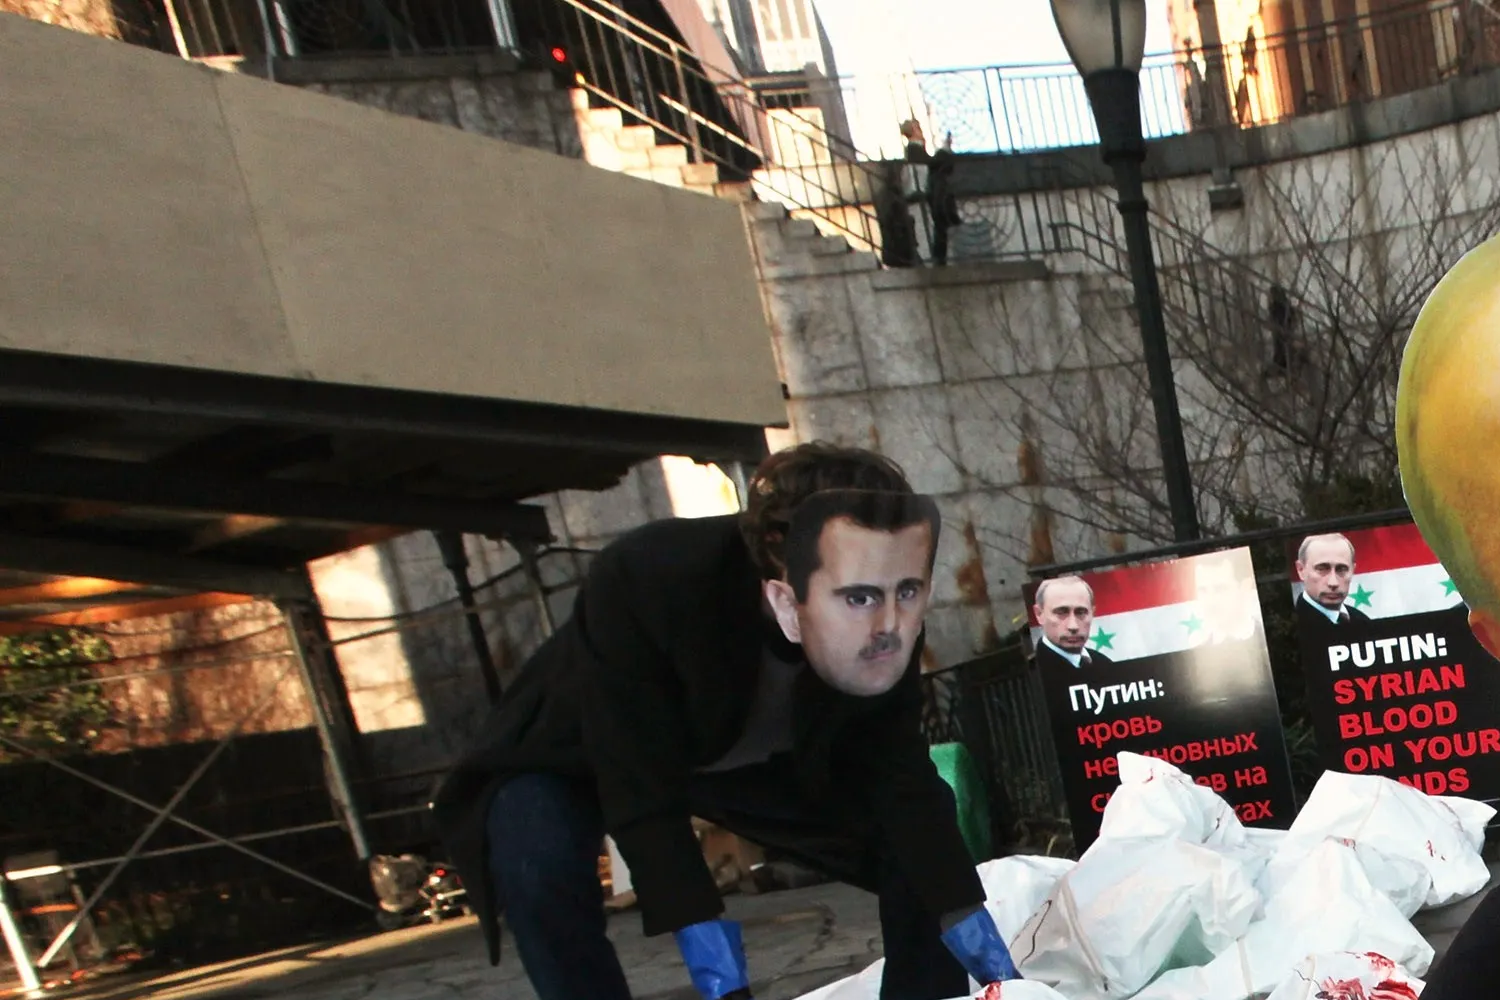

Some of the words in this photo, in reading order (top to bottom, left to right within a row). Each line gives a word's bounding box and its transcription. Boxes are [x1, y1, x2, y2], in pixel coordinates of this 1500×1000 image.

[1328, 633, 1448, 671] PUTIN:
[1068, 679, 1165, 715] Путин:
[1334, 664, 1466, 704] SYRIAN
[1076, 715, 1163, 748] кровь
[1339, 701, 1458, 739] BLOOD
[1344, 744, 1395, 772] ON
[1234, 765, 1268, 788] на
